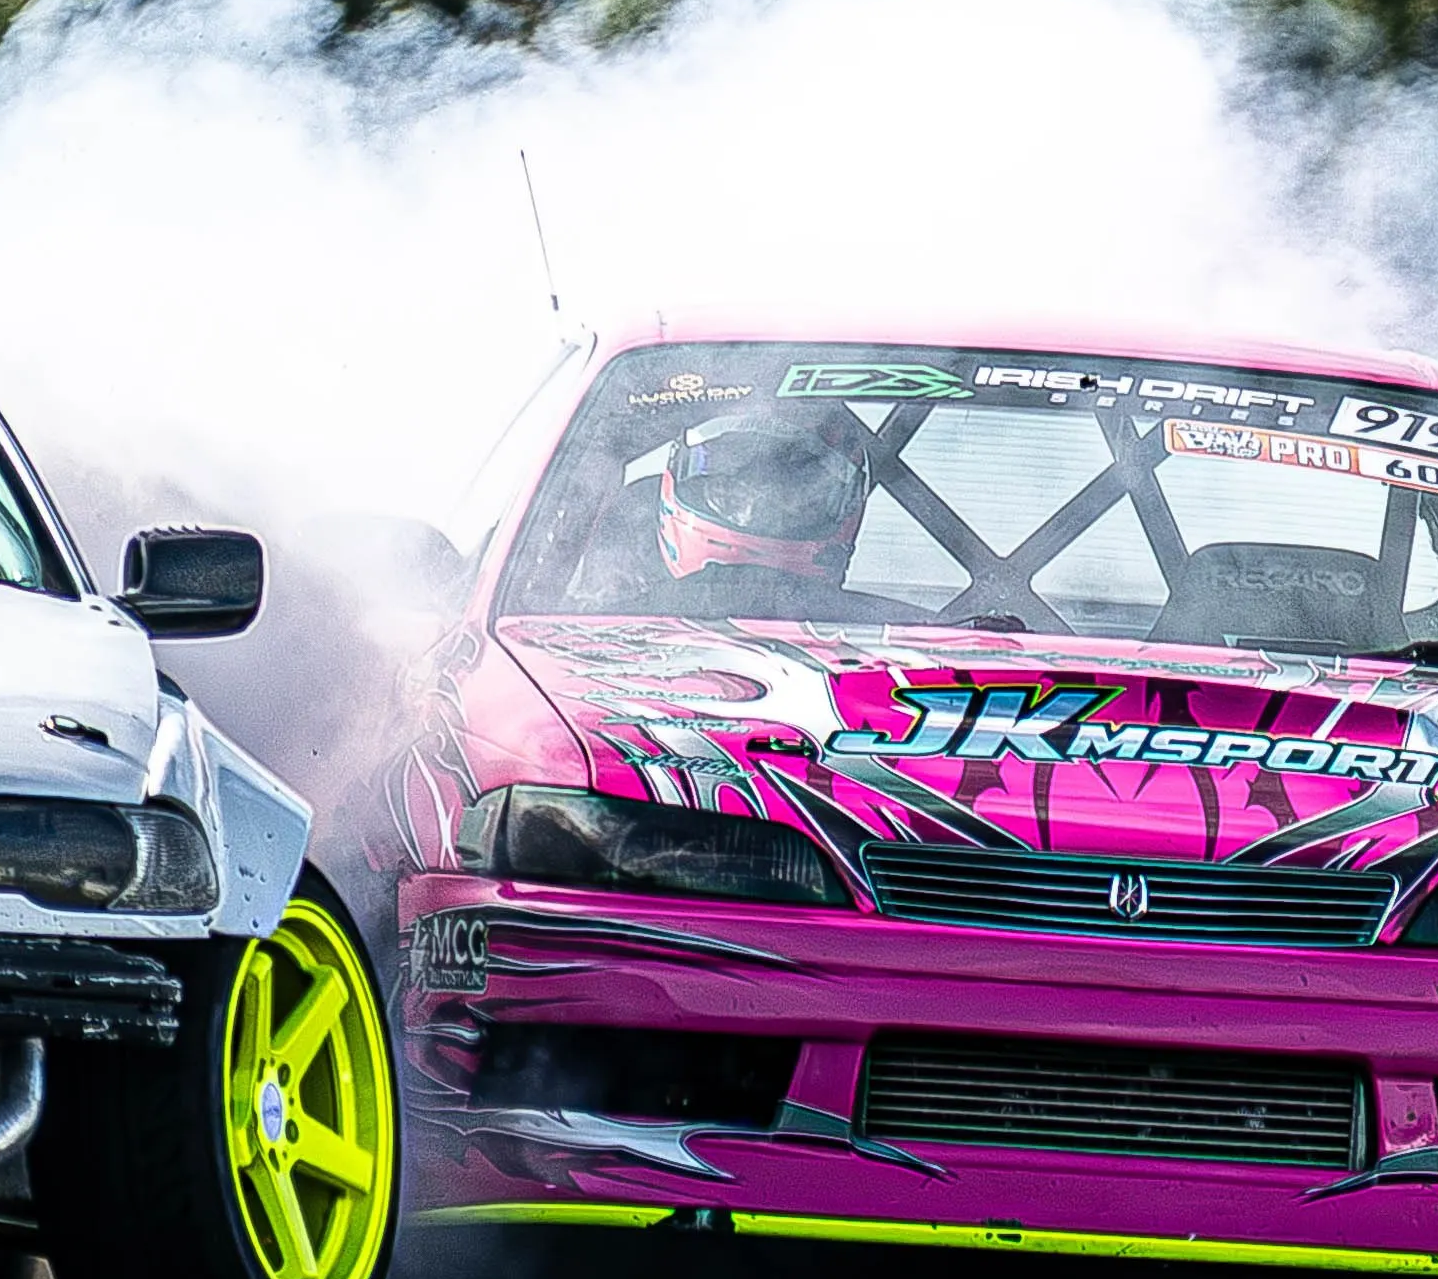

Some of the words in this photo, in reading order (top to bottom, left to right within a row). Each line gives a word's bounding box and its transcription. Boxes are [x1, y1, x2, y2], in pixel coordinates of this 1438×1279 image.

[1138, 377, 1315, 414] DRIFT
[1269, 435, 1352, 472] PRO
[430, 916, 486, 965] MCG
